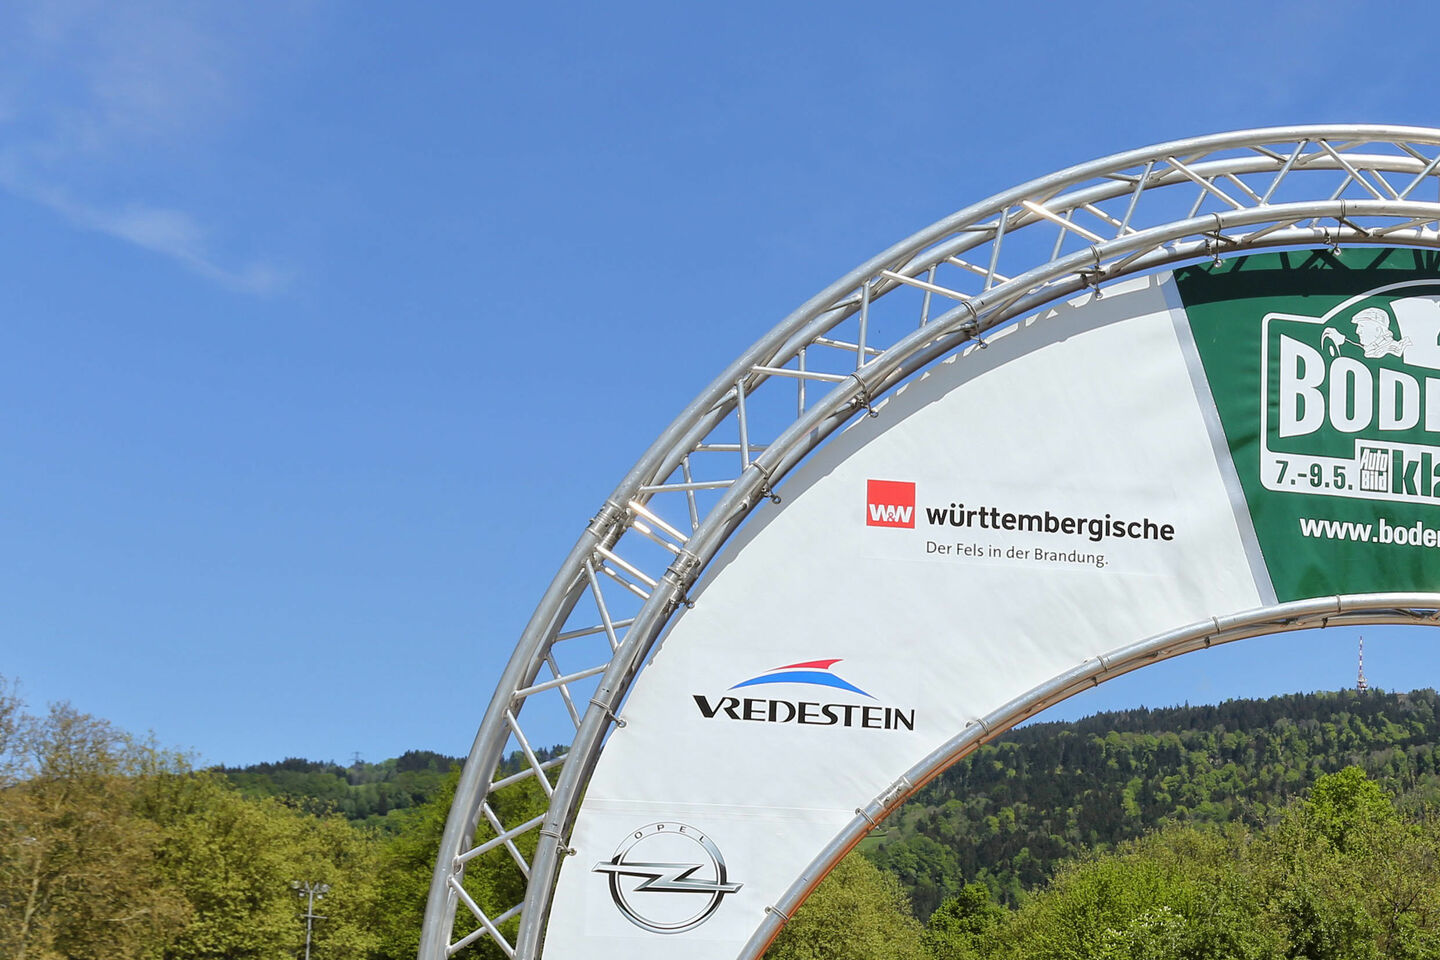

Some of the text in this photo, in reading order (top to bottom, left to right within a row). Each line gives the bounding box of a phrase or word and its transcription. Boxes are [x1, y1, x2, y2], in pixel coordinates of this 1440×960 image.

[1360, 447, 1389, 471] Auto
[1360, 468, 1387, 492] Bild
[925, 502, 1175, 542] württembergische
[926, 541, 1109, 568] Der Fels in der Brandung.
[691, 693, 916, 732] VREDESTEIN
[634, 822, 707, 844] OPEL
